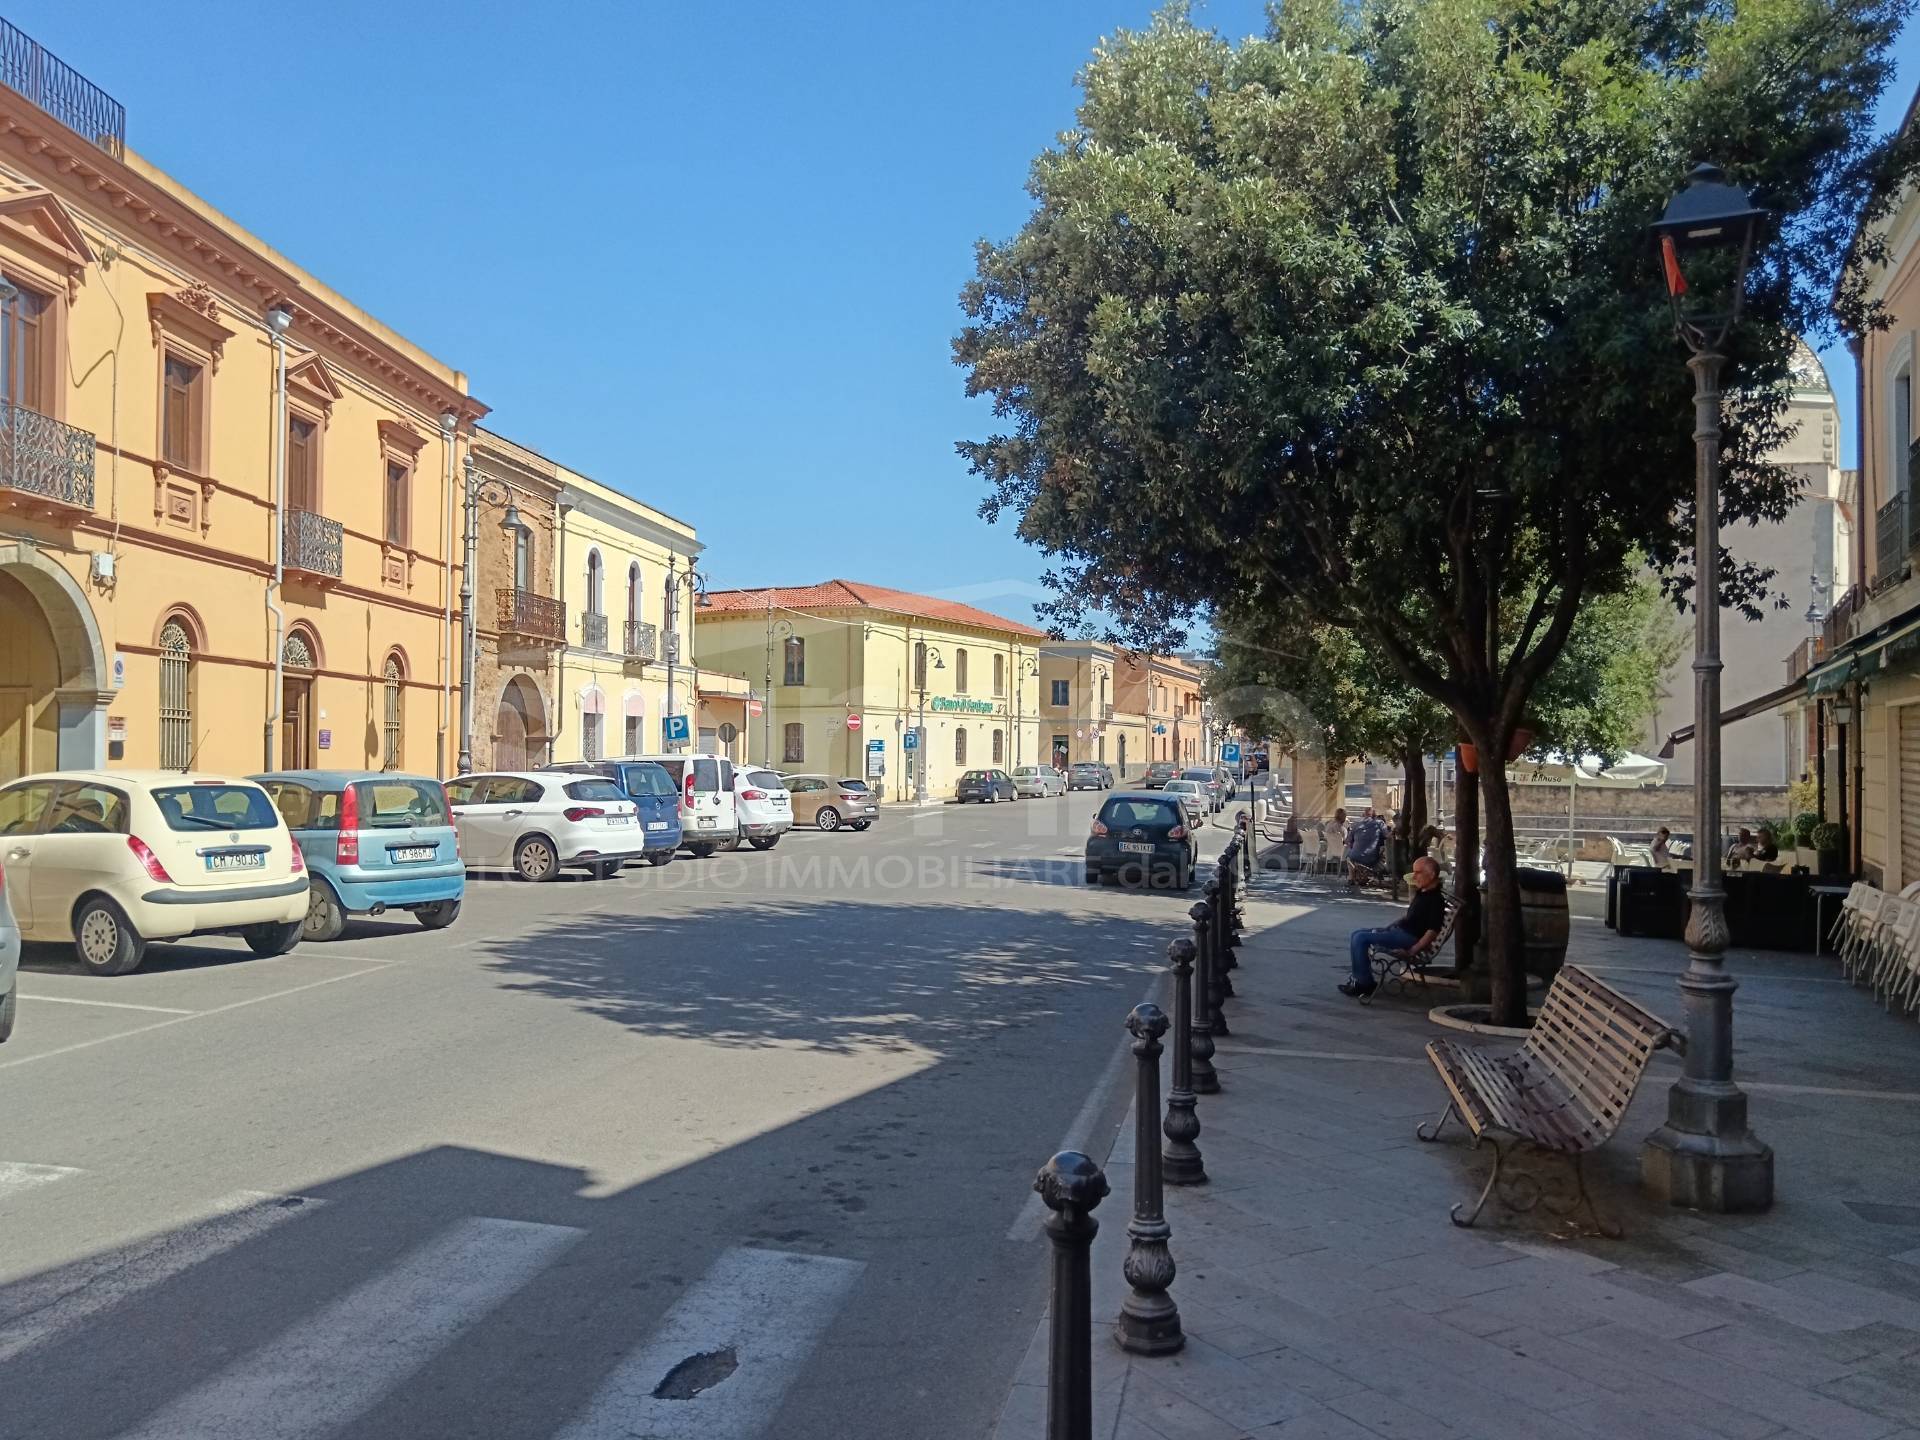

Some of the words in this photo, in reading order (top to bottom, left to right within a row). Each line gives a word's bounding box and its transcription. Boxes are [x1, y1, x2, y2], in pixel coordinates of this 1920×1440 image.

[669, 718, 684, 737] P
[906, 735, 915, 747] P
[1224, 745, 1236, 759] P
[213, 855, 226, 868] CM
[229, 853, 259, 867] 790JS
